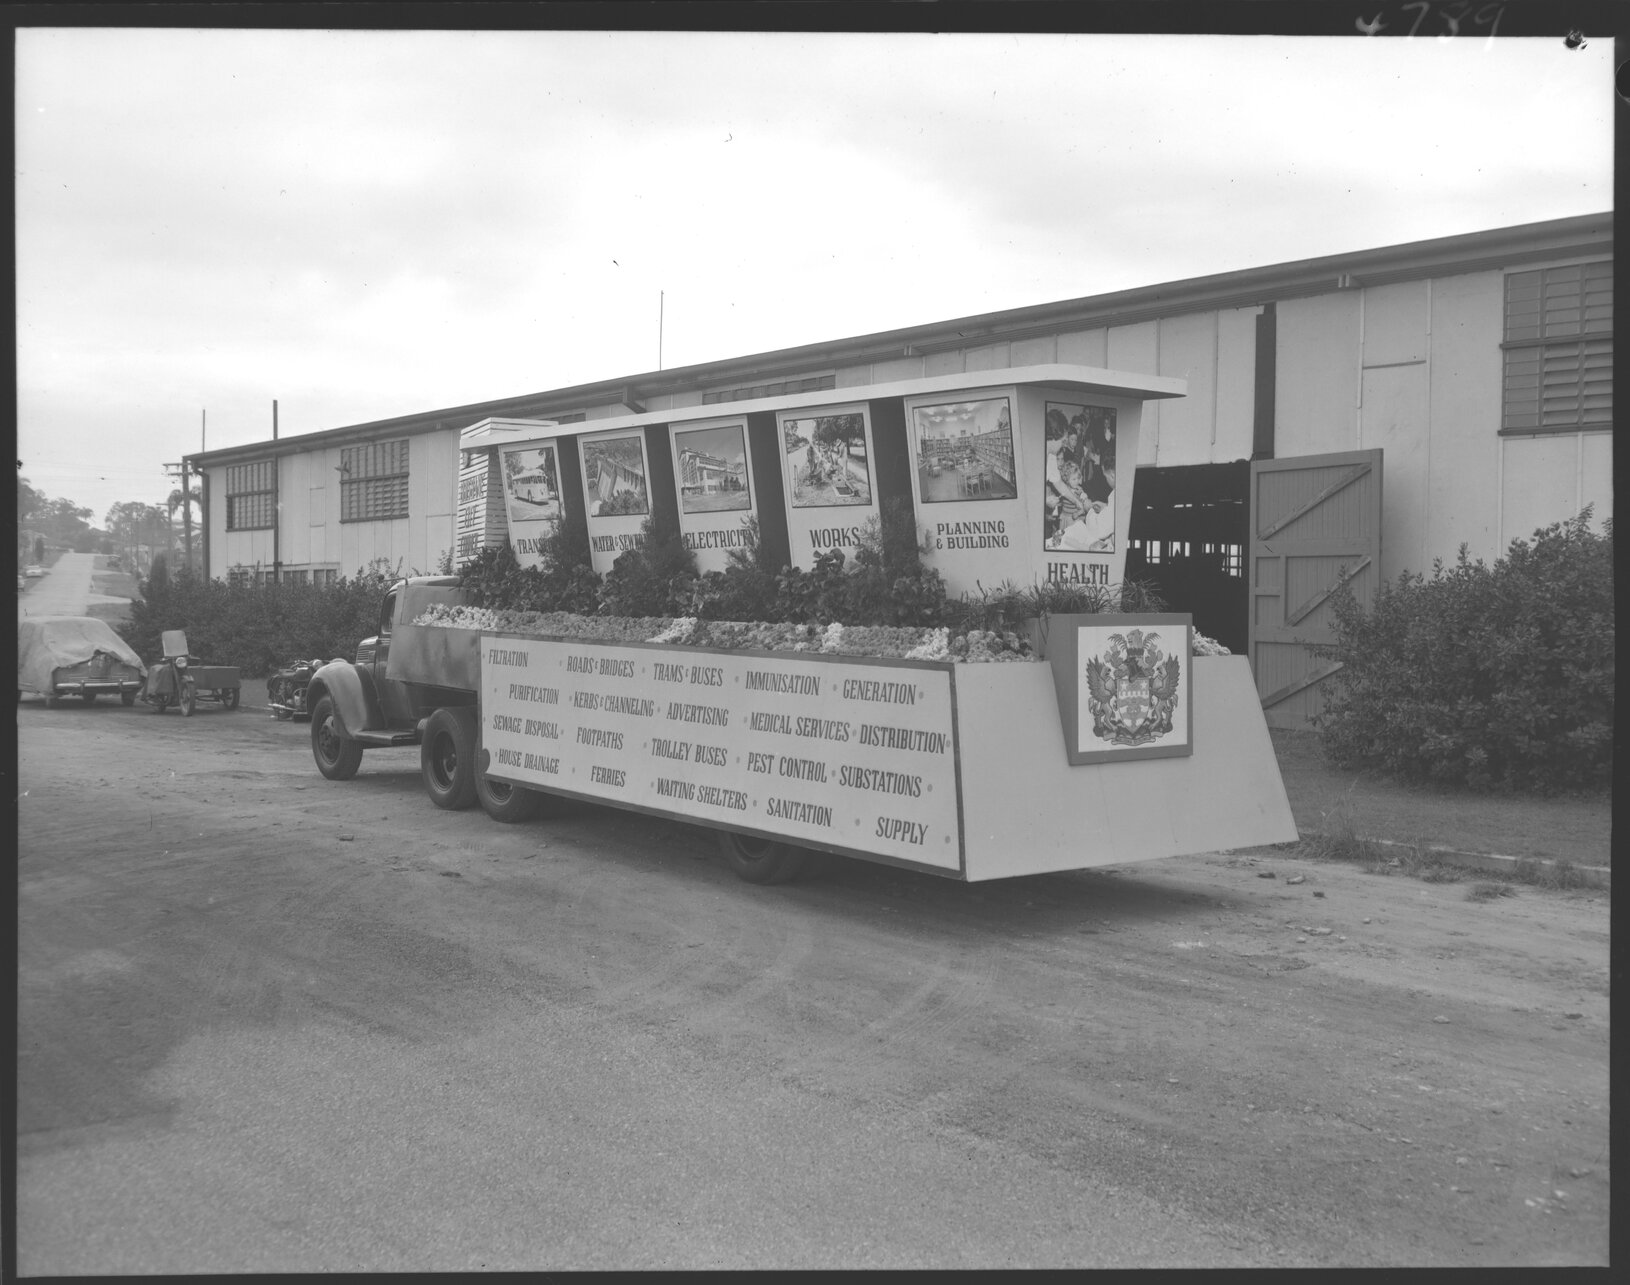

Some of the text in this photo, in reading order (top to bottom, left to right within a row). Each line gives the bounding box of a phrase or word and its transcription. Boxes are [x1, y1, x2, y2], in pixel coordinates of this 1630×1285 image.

[809, 527, 861, 548] WORKS
[936, 520, 1005, 536] PLANNING
[591, 535, 616, 553] WATER
[614, 537, 619, 547] &
[936, 535, 1009, 549] & BUILDING
[1047, 562, 1109, 585] HEALTH
[488, 649, 529, 667] FILTRATION
[567, 656, 593, 674] ROADS
[599, 658, 634, 678] BRIDGES
[654, 663, 684, 683] TRAMS
[690, 666, 723, 687] BUSES
[745, 671, 820, 696] IMMUNISATION
[509, 683, 559, 705] PURIFICATION
[573, 691, 599, 710] KERBS
[604, 697, 655, 717] CHANNELING
[843, 679, 916, 705] GENERATION
[493, 714, 559, 739] SEWAGE DISPOSAL
[666, 702, 729, 727] ADVERTISING
[749, 711, 850, 742] MEDICAL SERVICES
[576, 726, 624, 750] FOOTPATHS
[859, 724, 946, 754] DISTRIBUTION
[498, 748, 560, 775] HOUSE DRAINAGE
[651, 738, 728, 767] TROLLEY BUSES
[590, 765, 626, 788] FERRIES
[747, 752, 827, 783] PEST CONTROL
[656, 777, 748, 811] WAITING SHELTERS
[839, 765, 922, 798] SUBSTATIONS
[766, 797, 832, 827] SANITATION
[875, 816, 929, 845] SUPPLY
